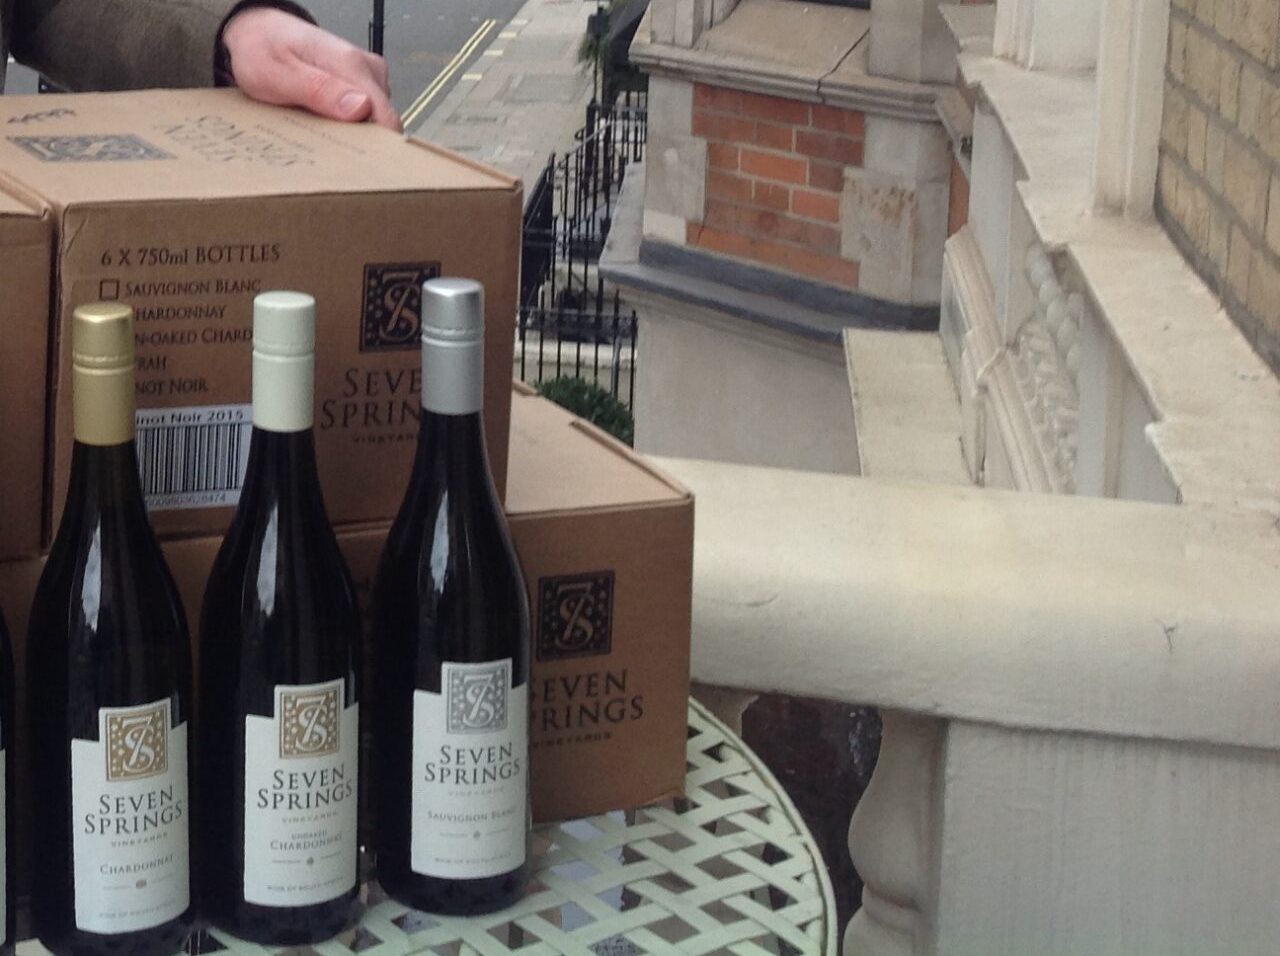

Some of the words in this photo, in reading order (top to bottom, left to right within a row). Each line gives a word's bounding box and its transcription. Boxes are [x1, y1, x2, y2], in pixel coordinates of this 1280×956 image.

[100, 250, 112, 267] 6
[118, 248, 131, 266] X
[137, 246, 189, 266] 750ml
[195, 244, 281, 265] BOTTLES
[125, 281, 210, 297] SAUVIGNON
[216, 278, 262, 294] BLANC
[135, 305, 227, 322] HARDONNAY
[134, 329, 198, 345] N-OAKED
[137, 356, 167, 371] RAH
[169, 377, 209, 392] NOIR
[343, 367, 422, 399] SEVE
[136, 415, 166, 426] inot
[171, 413, 202, 424] Noir
[207, 410, 244, 422] 2015
[321, 398, 422, 431] SPRIN
[541, 669, 628, 703] EVEN
[440, 742, 512, 765] SEVEN
[272, 764, 345, 790] SEVEN
[424, 757, 521, 785] SPRINGS
[99, 785, 173, 815] SEVEN
[257, 779, 353, 810] SPRINGS
[84, 800, 182, 835] SPRINGS
